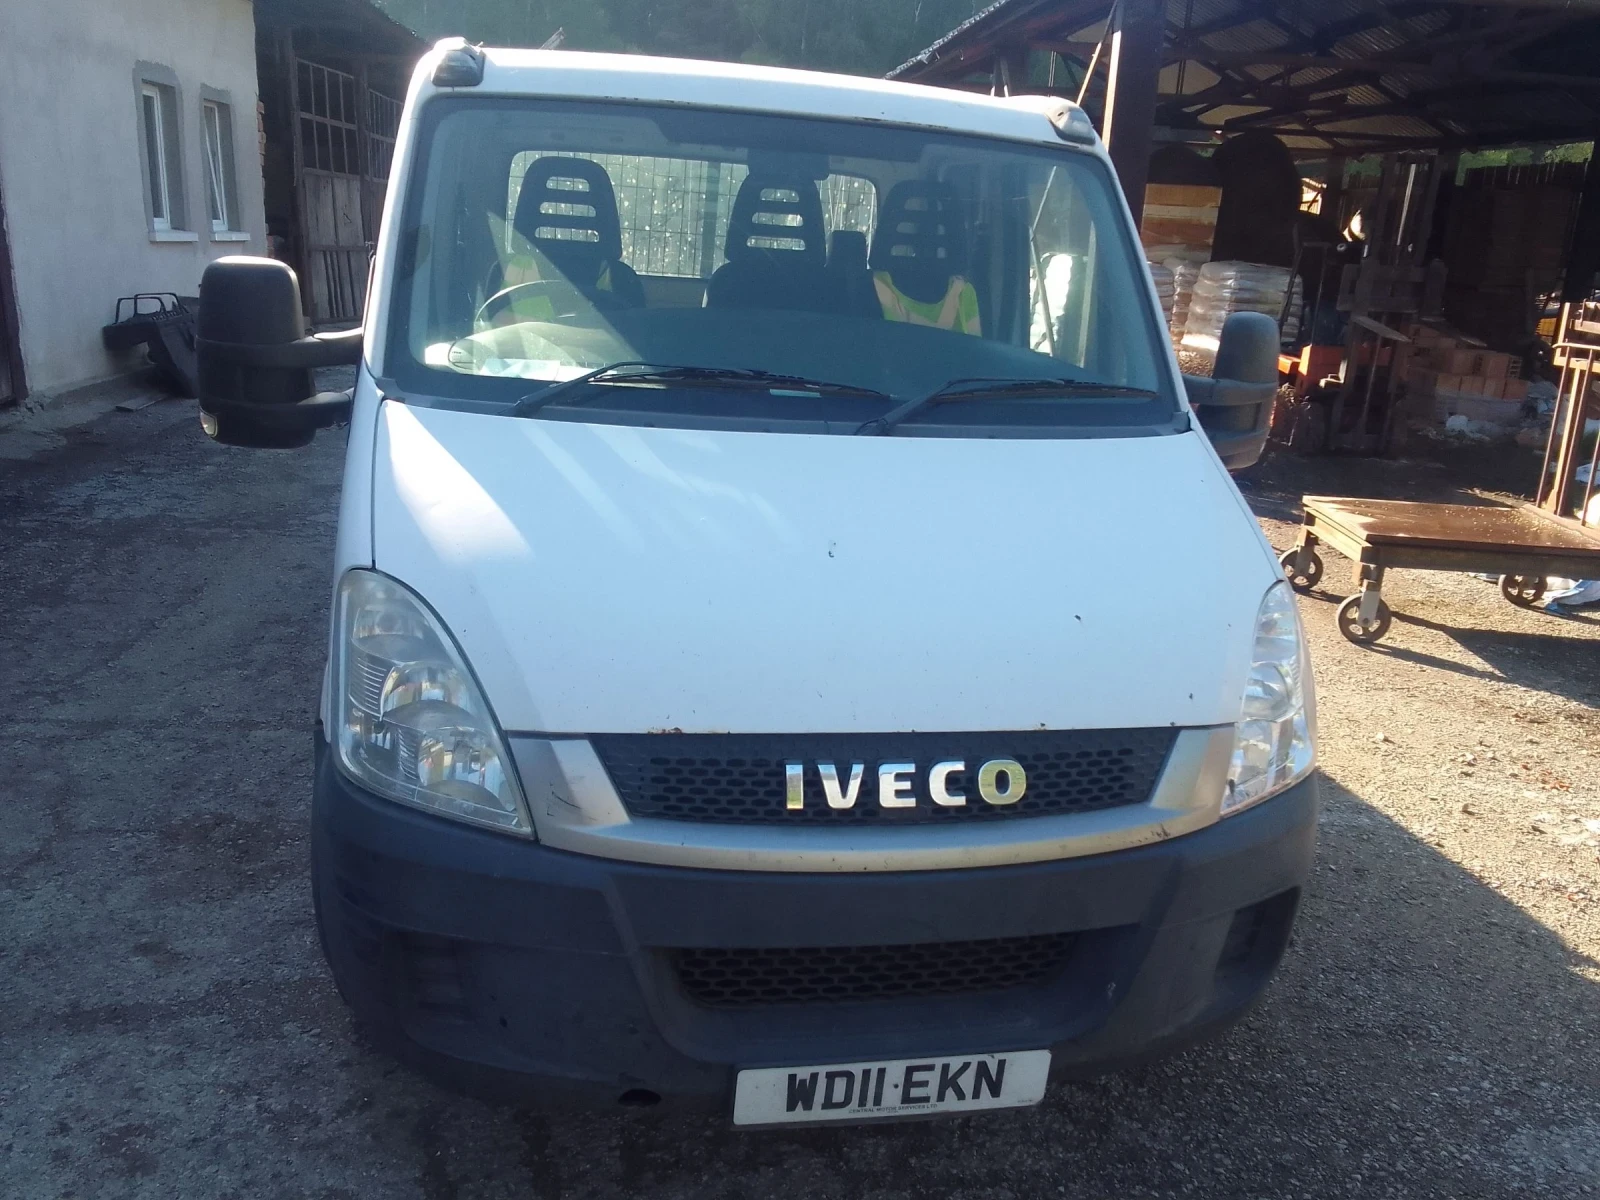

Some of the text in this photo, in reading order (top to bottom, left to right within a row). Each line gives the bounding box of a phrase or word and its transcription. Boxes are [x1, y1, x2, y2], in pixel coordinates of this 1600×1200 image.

[785, 759, 1027, 809] IVECO
[786, 1059, 1007, 1112] WD11 EKN
